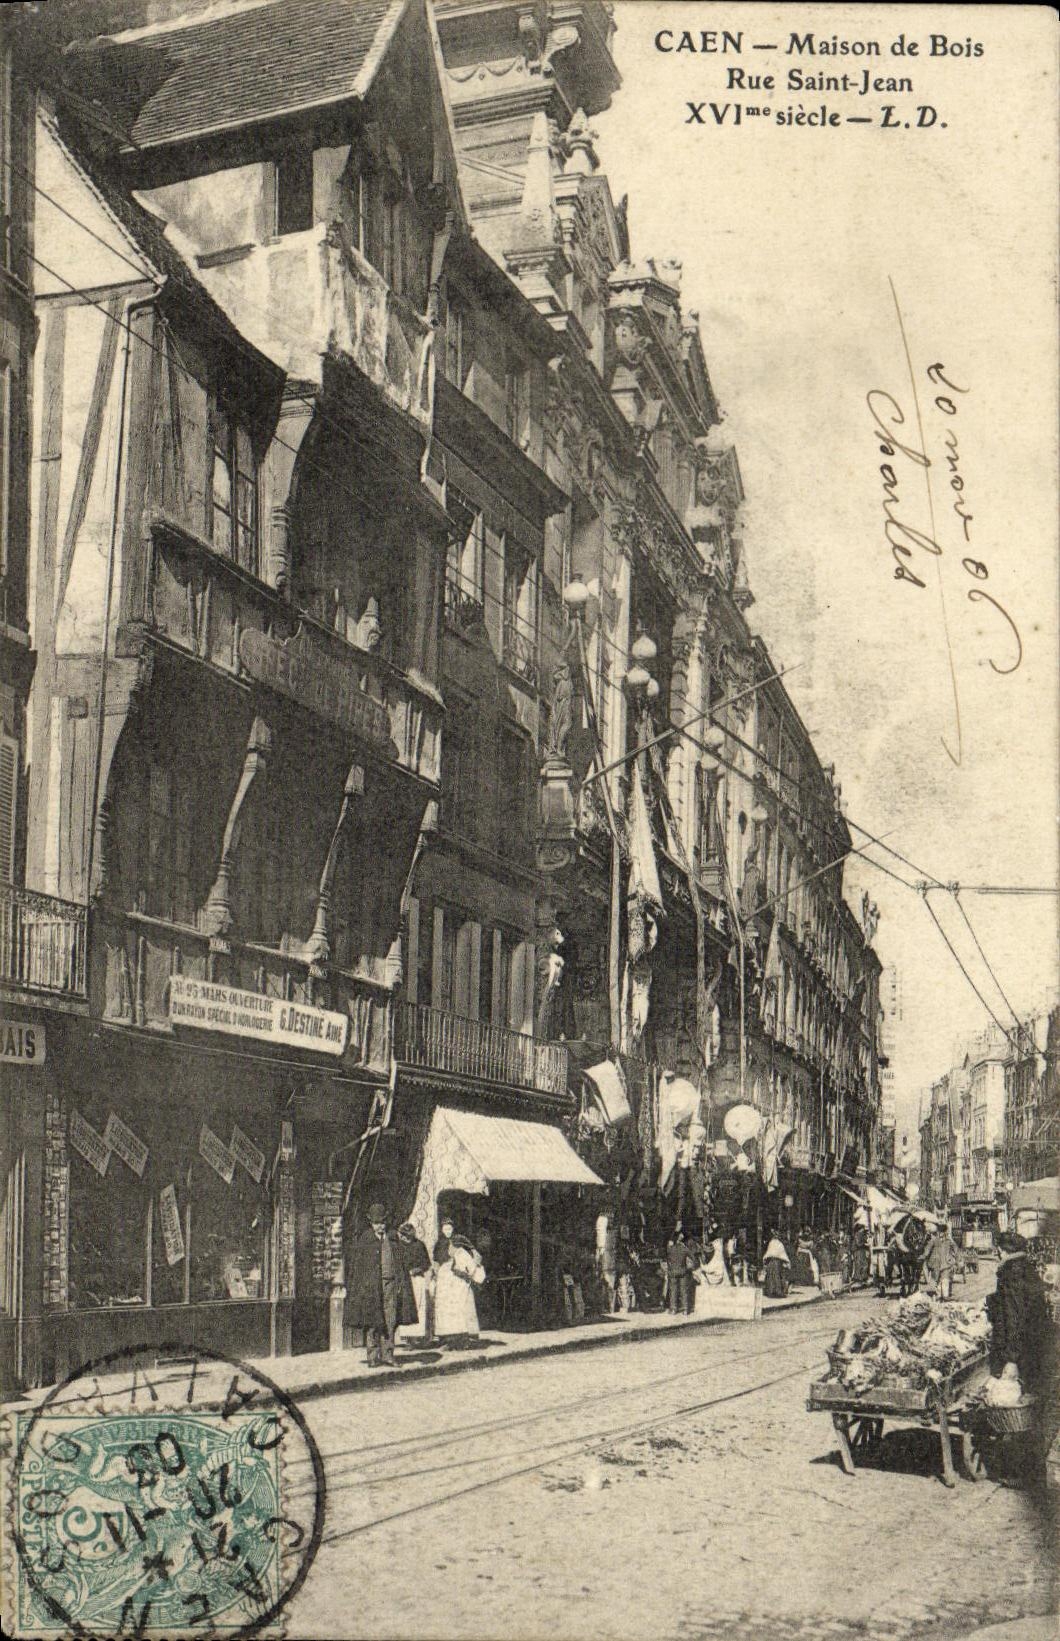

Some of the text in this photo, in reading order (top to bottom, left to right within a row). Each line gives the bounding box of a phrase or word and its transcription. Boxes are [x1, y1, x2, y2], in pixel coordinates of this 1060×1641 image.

[866, 389, 942, 588] Charles
[201, 986, 228, 1003] MARS
[229, 990, 274, 1013] OUVERTURE
[0, 1026, 36, 1059] AIS
